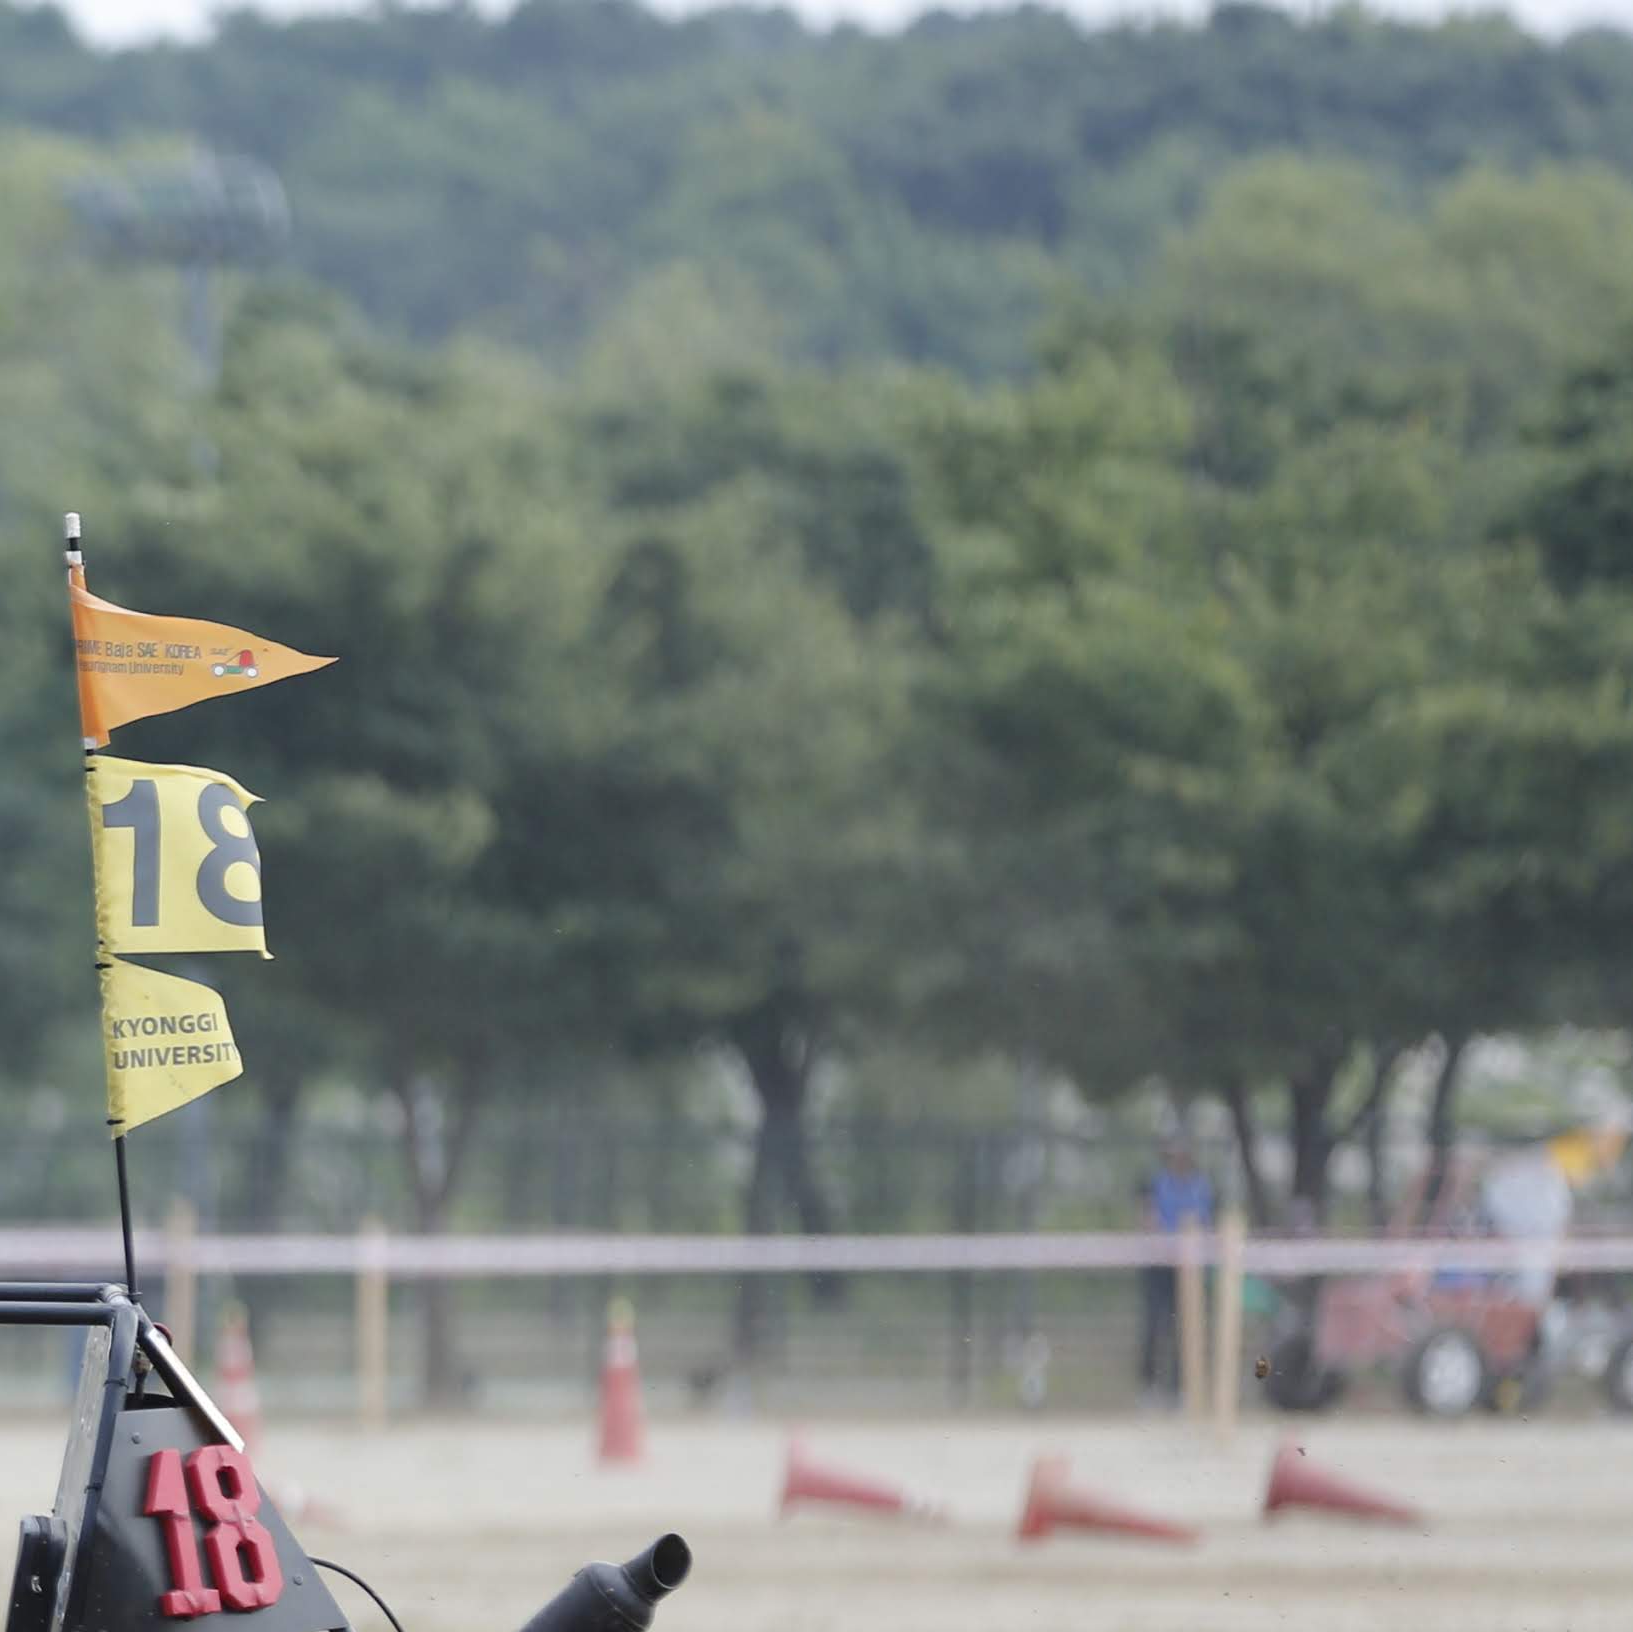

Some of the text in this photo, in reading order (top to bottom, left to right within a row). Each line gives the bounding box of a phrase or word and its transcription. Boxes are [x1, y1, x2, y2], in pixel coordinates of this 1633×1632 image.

[105, 641, 134, 658] Baja
[137, 642, 158, 659] SAE
[165, 644, 201, 660] KOREA
[129, 662, 185, 676] University
[103, 778, 264, 928] 18
[113, 1012, 219, 1040] KYONGGI
[143, 1443, 285, 1619] 18
